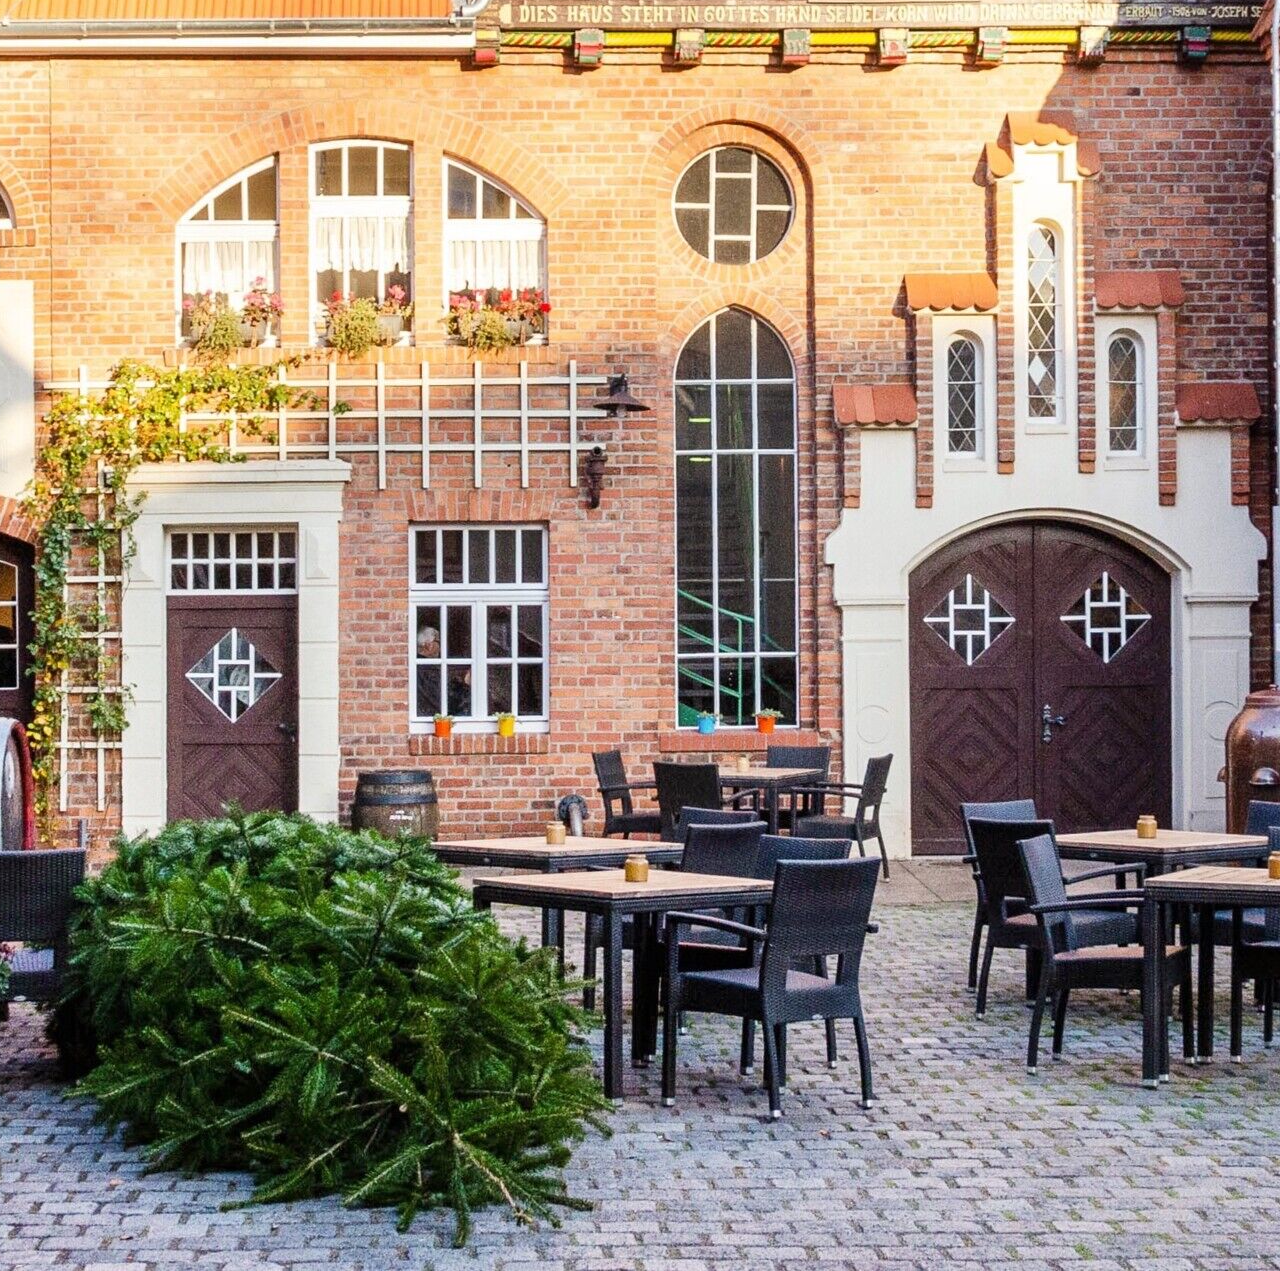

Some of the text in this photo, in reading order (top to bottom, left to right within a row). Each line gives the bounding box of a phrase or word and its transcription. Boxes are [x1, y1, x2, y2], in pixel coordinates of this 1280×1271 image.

[519, 5, 557, 23] DIES
[567, 5, 613, 23] HAUS
[621, 5, 677, 23] STEHT
[680, 6, 699, 23] IN
[704, 5, 769, 23] GOTTES
[774, 5, 821, 23] HAND
[1211, 6, 1249, 18] JOSEPH
